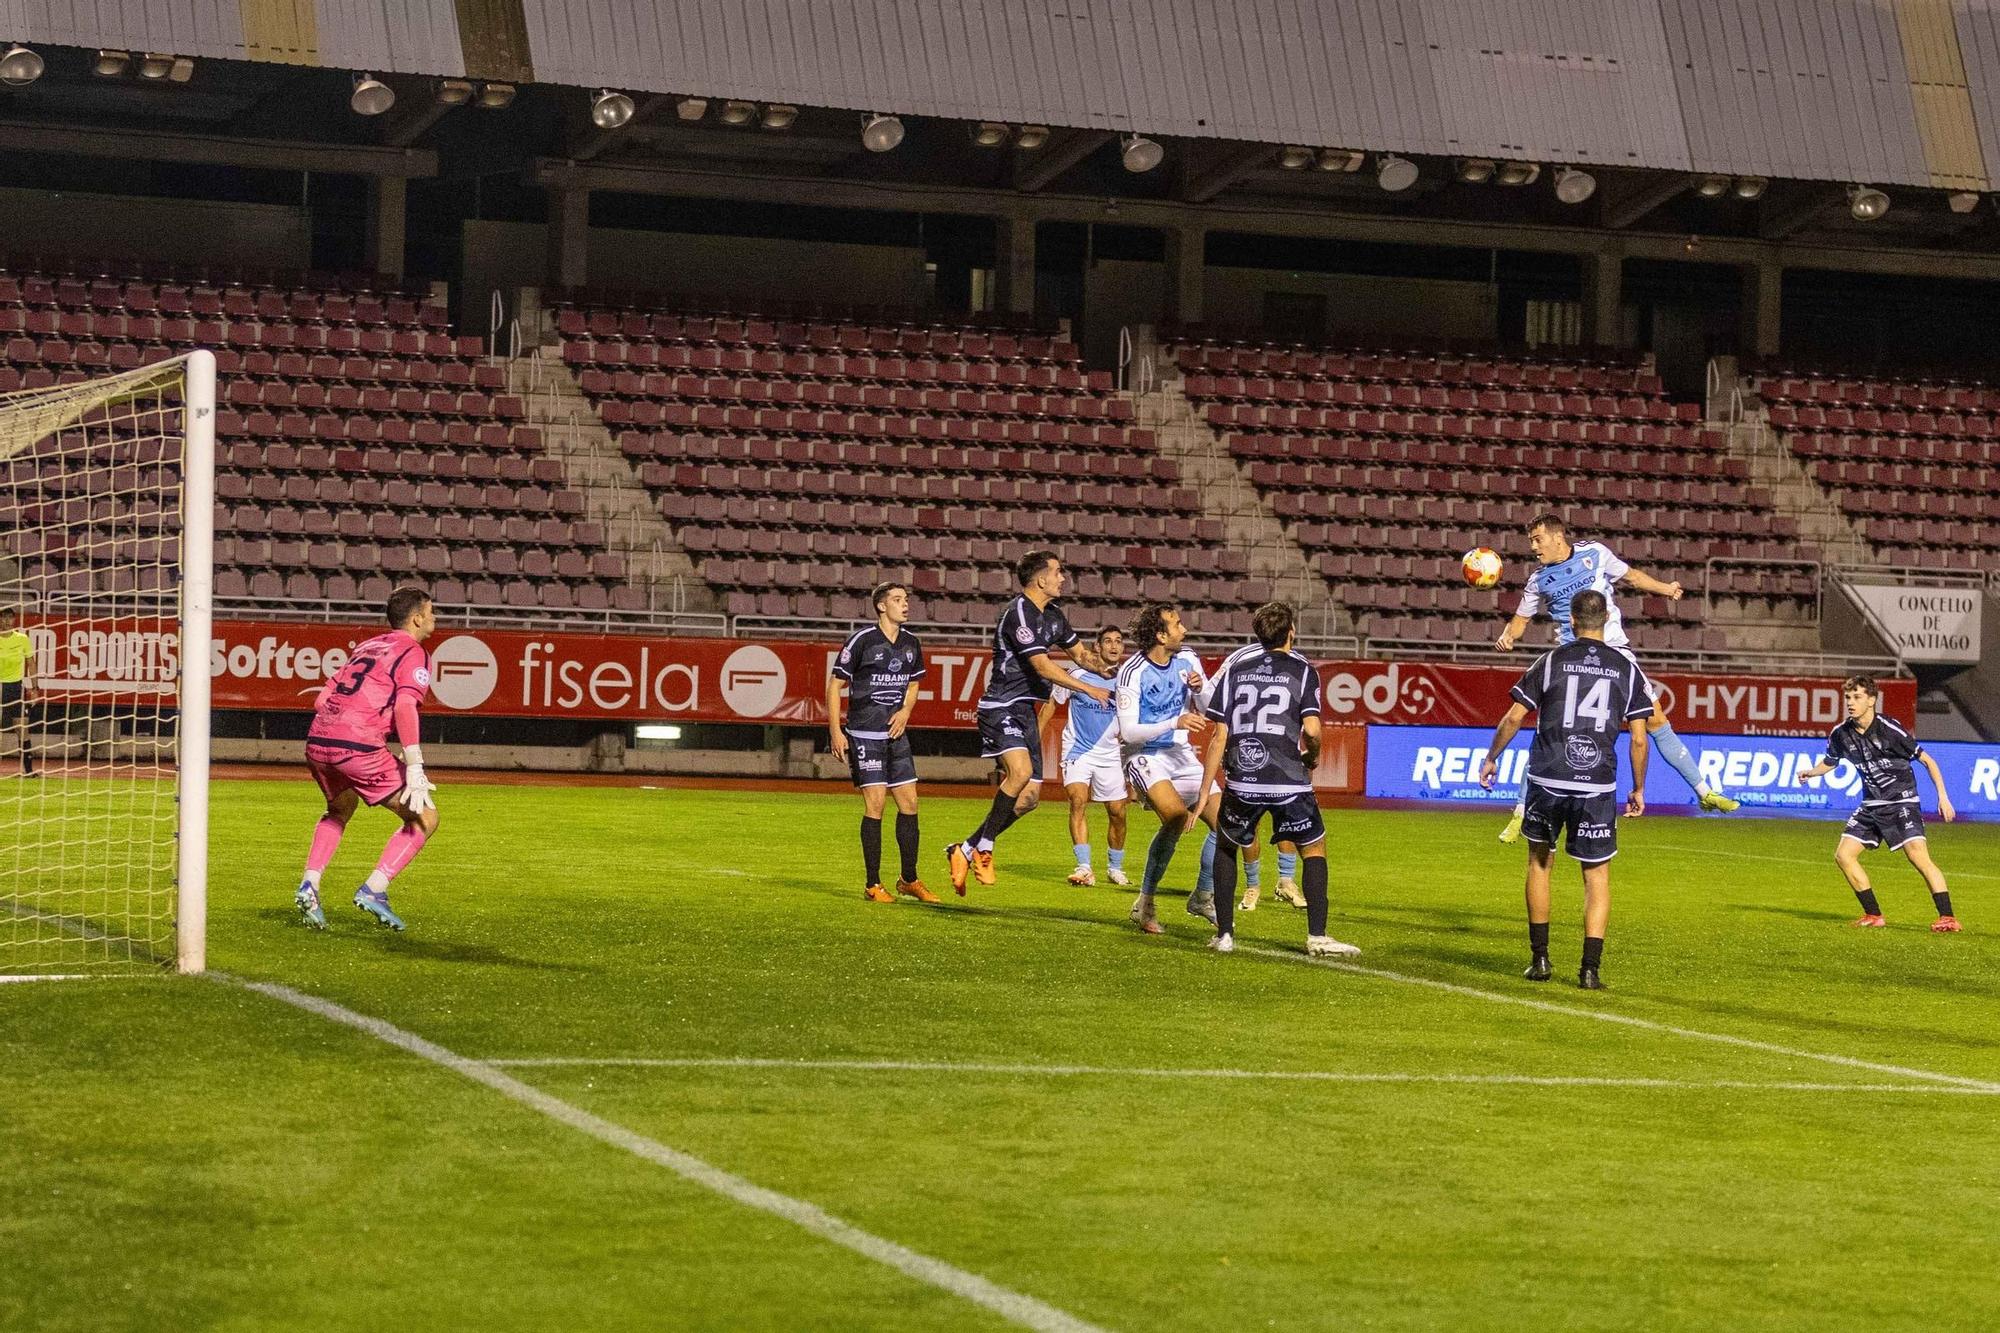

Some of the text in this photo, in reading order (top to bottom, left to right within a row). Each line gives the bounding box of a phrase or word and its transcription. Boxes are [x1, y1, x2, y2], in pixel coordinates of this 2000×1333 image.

[1552, 576, 1597, 600] SANTIAGO
[1899, 595, 1973, 613] CONCELLO
[1923, 615, 1942, 631] DE
[1898, 633, 1970, 650] SANTIAGO
[70, 629, 177, 681] SPORTS
[519, 642, 699, 711] fisela
[1563, 664, 1620, 679] LOLITAMODA.COM
[1232, 684, 1291, 736] 22
[1562, 674, 1612, 732] 14
[1687, 684, 1884, 724] HYUNDI
[857, 745, 866, 759] 3
[1452, 789, 1487, 798] ACERO
[1278, 821, 1312, 833] DAKAR
[1577, 829, 1611, 839] DAKAR
